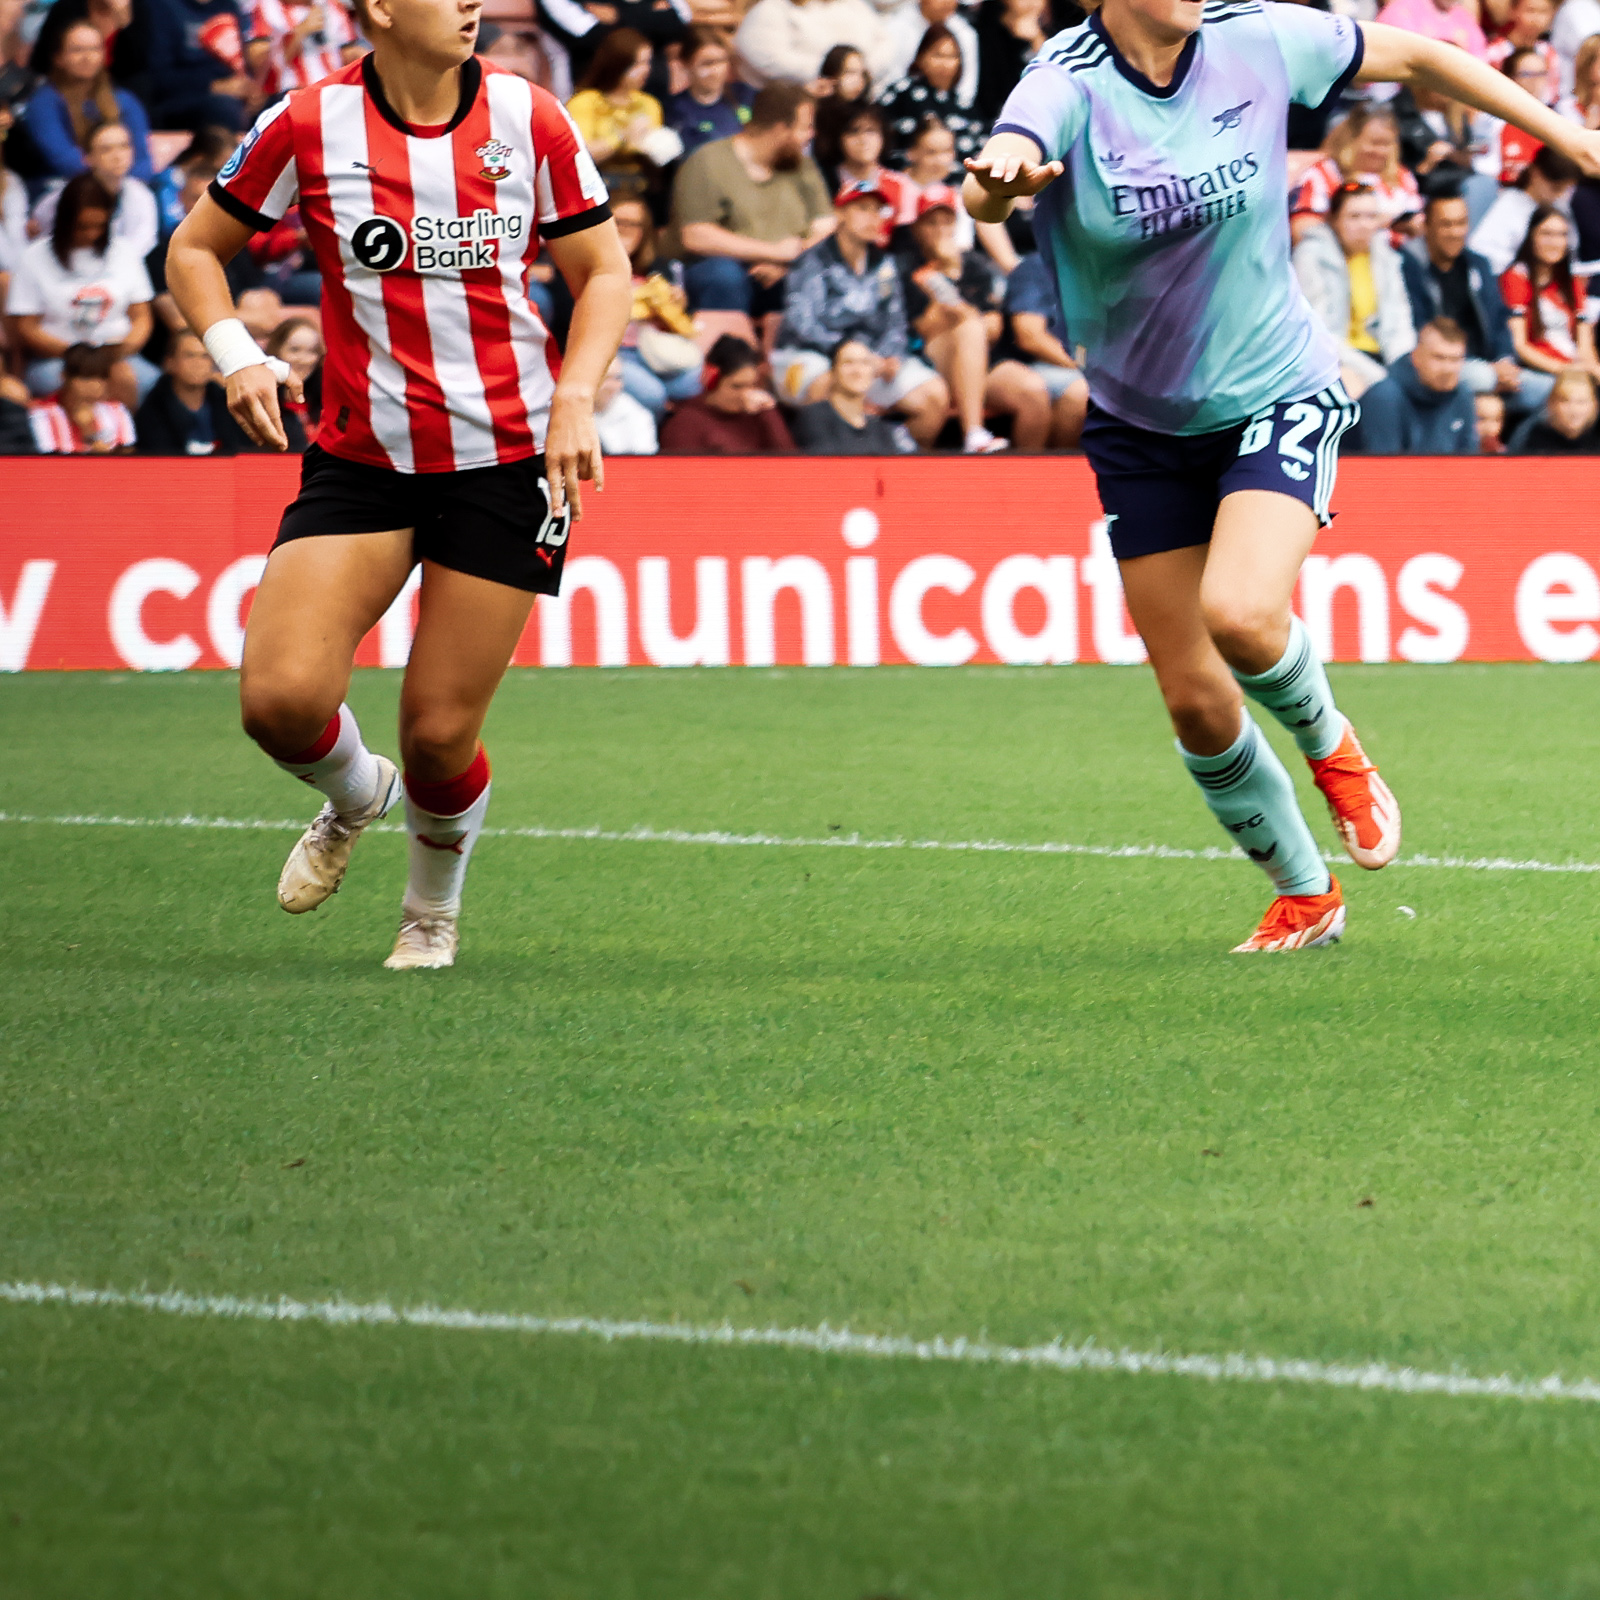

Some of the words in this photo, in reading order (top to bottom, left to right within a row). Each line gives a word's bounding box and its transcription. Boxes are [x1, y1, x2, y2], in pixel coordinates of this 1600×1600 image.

[1110, 151, 1259, 217] Emirates
[415, 212, 523, 240] Starling
[1140, 211, 1172, 240] FLY
[1181, 189, 1247, 230] BETTER
[416, 241, 491, 269] Bank
[1238, 401, 1325, 467] 62
